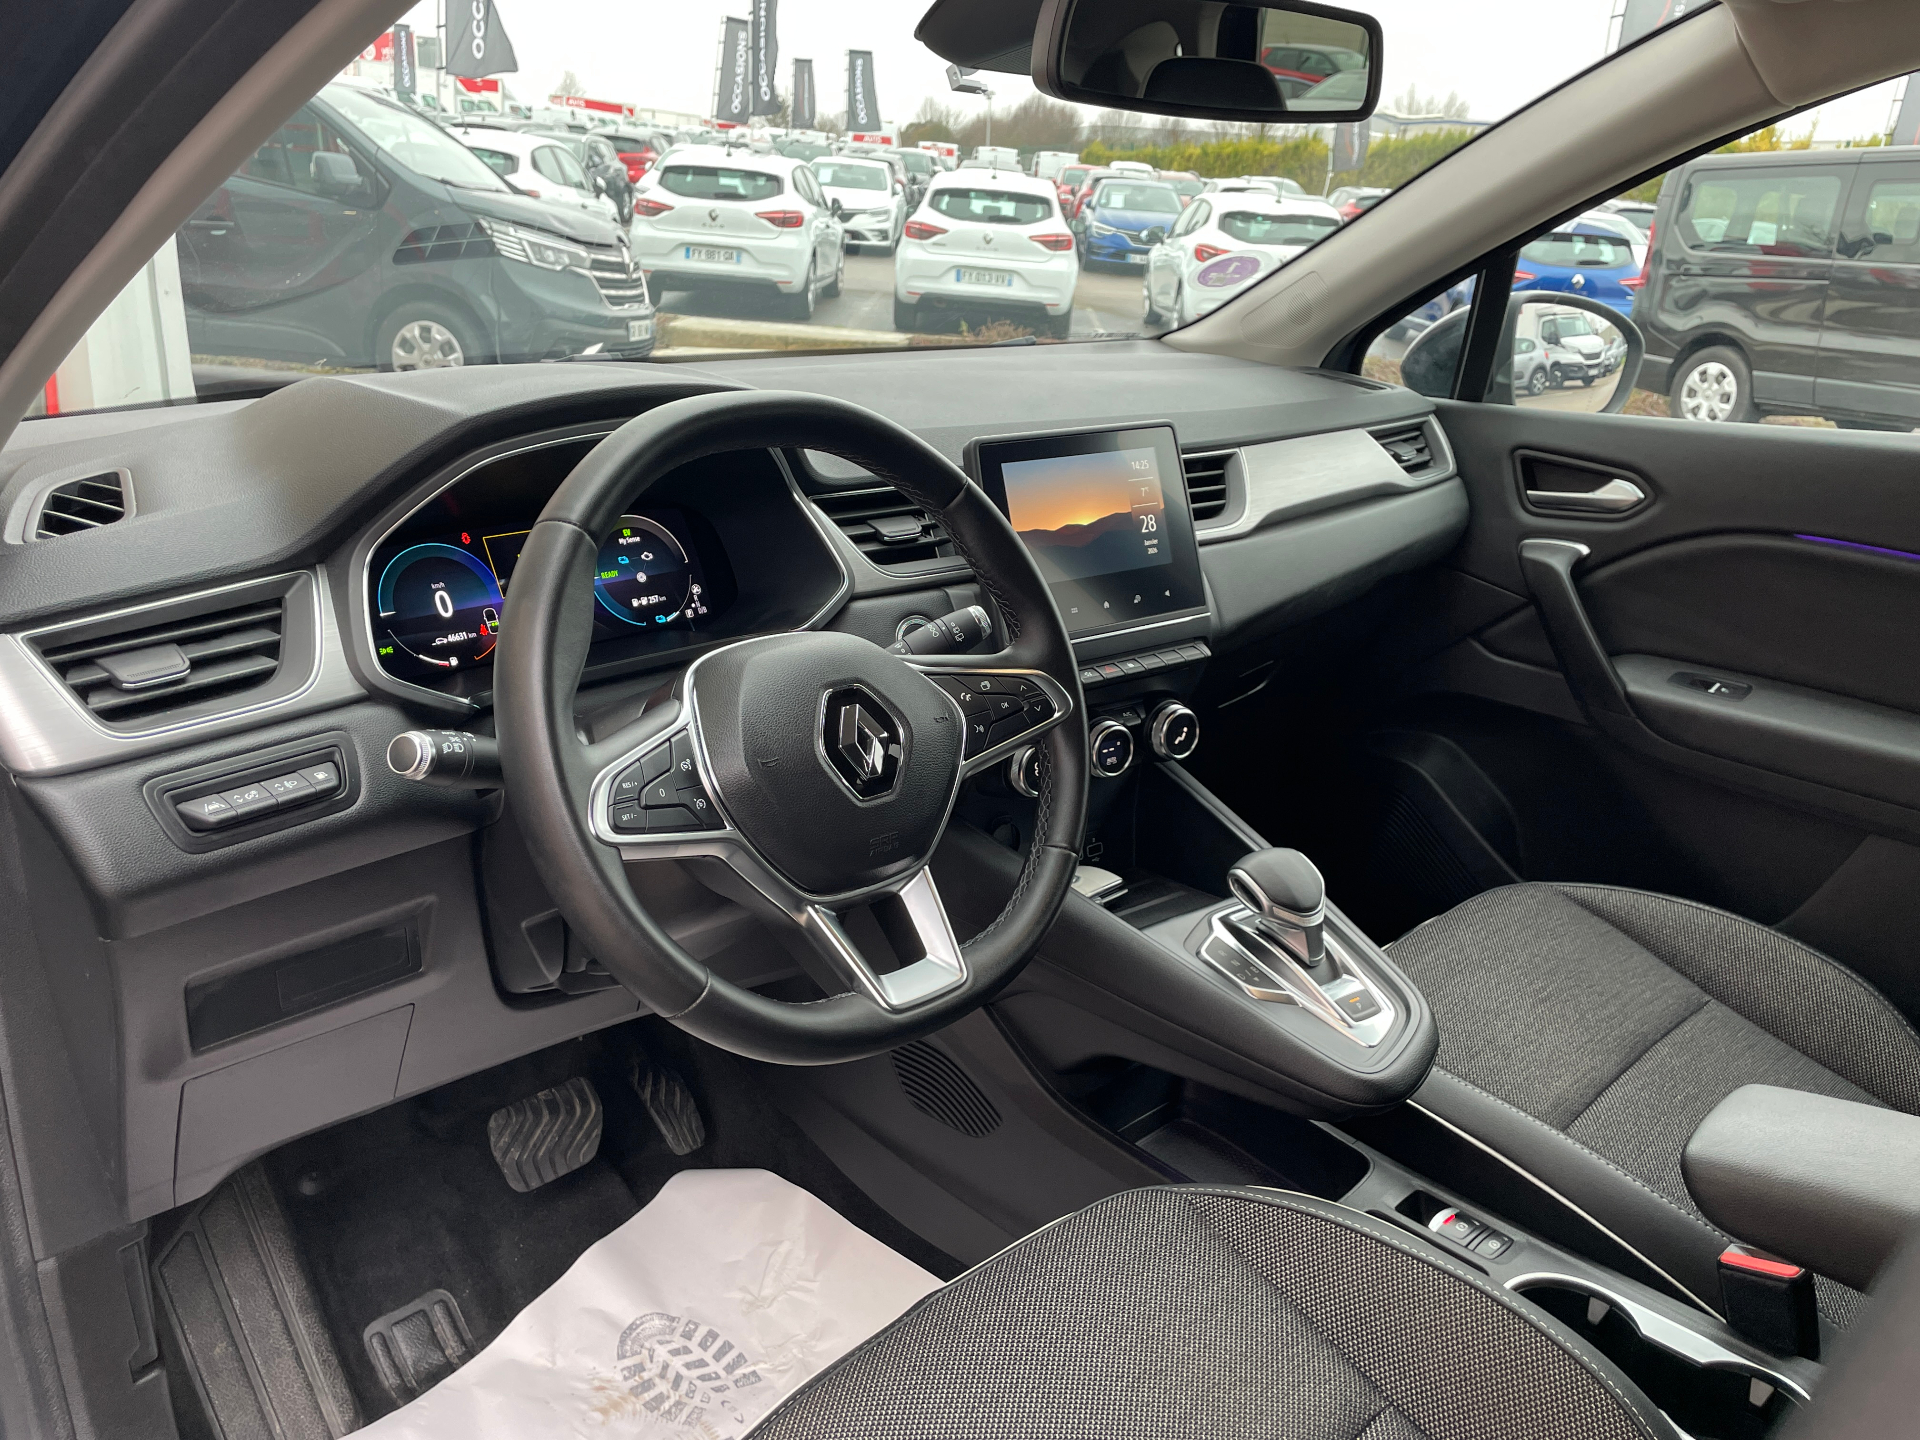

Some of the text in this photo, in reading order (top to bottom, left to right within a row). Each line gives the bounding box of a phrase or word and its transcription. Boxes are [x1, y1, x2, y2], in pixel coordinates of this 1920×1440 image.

[730, 30, 748, 114] OCCASIONS
[854, 58, 868, 124] OCCASIONS
[1131, 459, 1150, 470] 14:25
[1139, 514, 1157, 533] 28
[622, 528, 632, 537] EV
[627, 536, 641, 544] Sense
[600, 570, 619, 579] READY
[430, 581, 446, 589] km/h
[434, 590, 454, 618] 0
[648, 594, 659, 604] 257
[447, 631, 467, 642] 46631
[1000, 701, 1010, 709] OK
